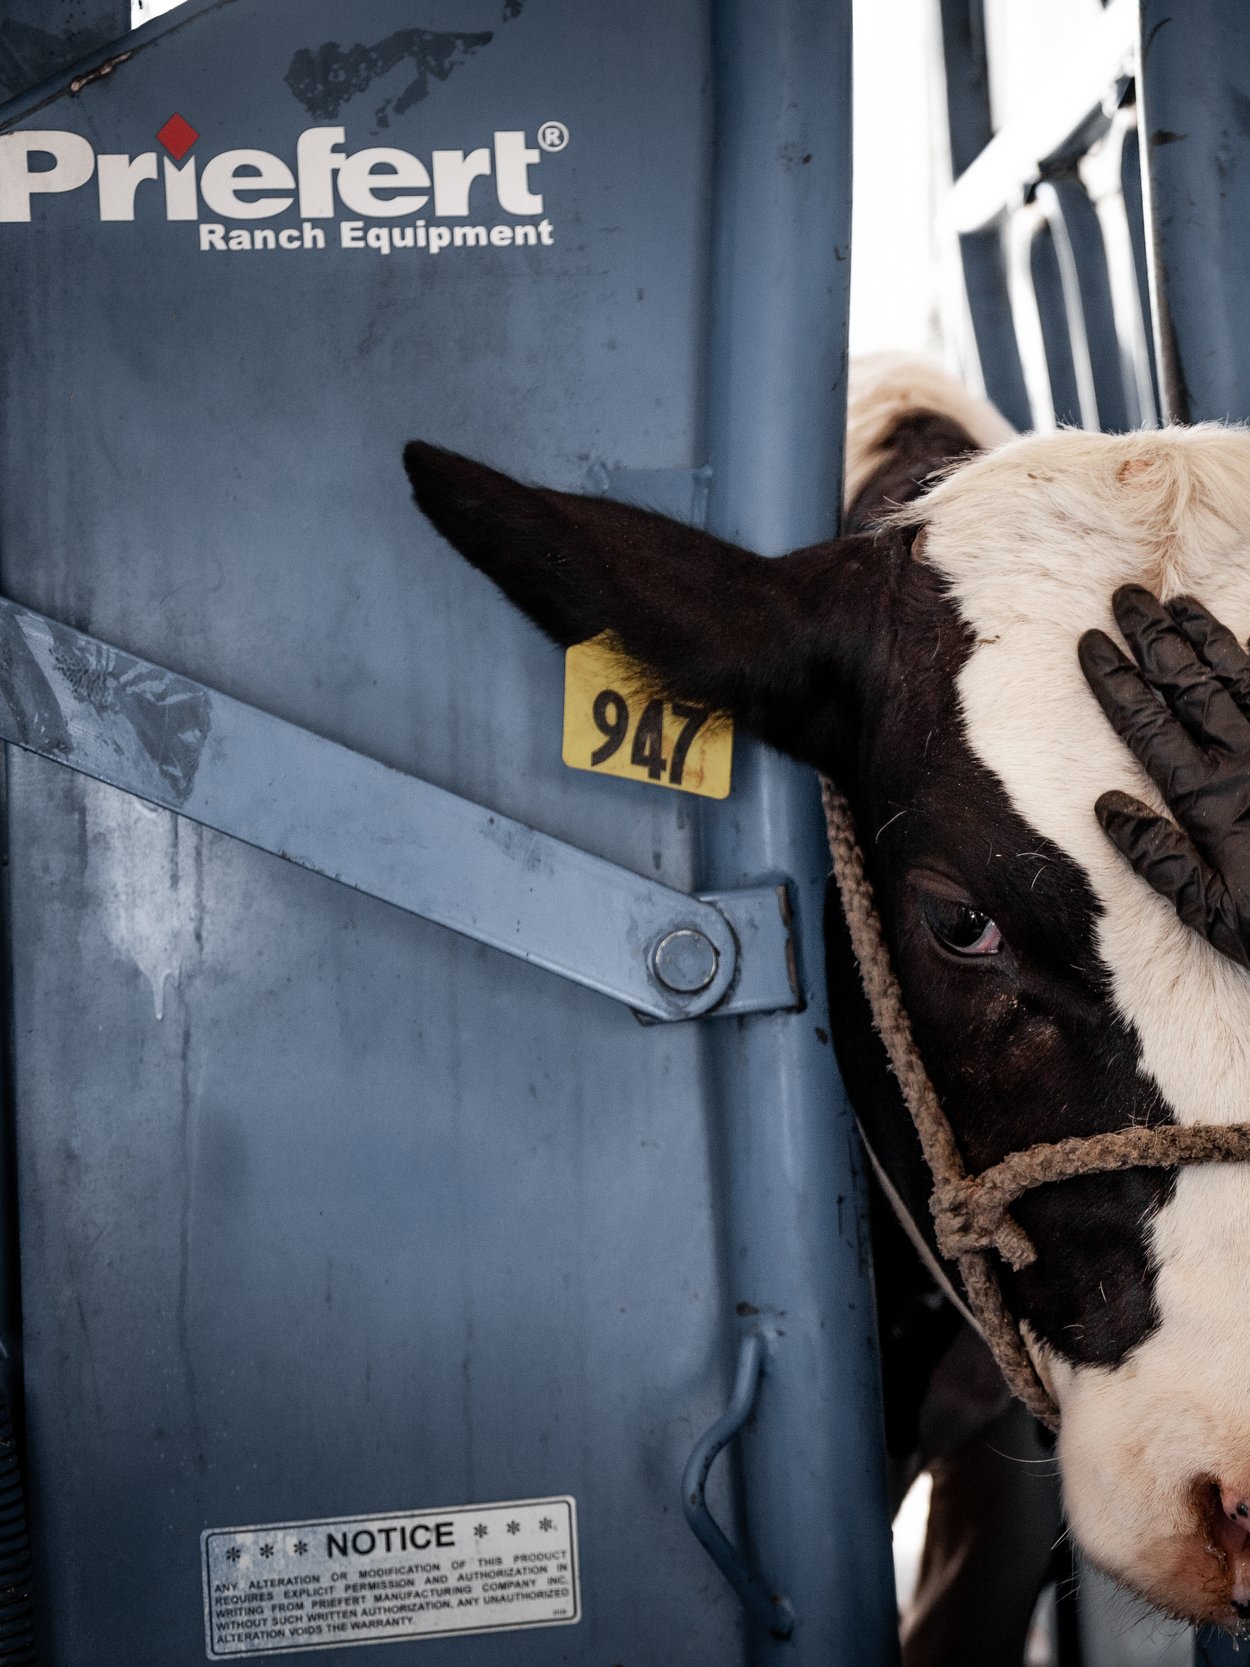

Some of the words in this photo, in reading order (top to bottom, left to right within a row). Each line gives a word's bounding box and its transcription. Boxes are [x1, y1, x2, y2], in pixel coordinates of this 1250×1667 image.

[200, 223, 325, 250] Ranch
[340, 220, 554, 255] Equipment
[591, 689, 707, 785] 947
[327, 1522, 455, 1558] NOTICE
[215, 1582, 238, 1593] ANY
[249, 1575, 320, 1590] ALTERATION
[331, 1572, 347, 1582] OR
[359, 1563, 440, 1579] MODIFICATION
[452, 1560, 466, 1570] OF
[478, 1558, 502, 1567] THIS
[514, 1550, 567, 1563] PRODUCT
[215, 1592, 273, 1606] REQUIRES
[284, 1586, 335, 1599] EXPLICIT
[345, 1578, 415, 1593] PERMISSION
[425, 1576, 447, 1585] AND
[457, 1566, 547, 1582] AUTHORIZATION
[557, 1564, 567, 1572] IN
[216, 1605, 263, 1618] WRITING
[272, 1602, 304, 1613] FROM
[312, 1596, 366, 1609] PRIEFERT
[374, 1586, 472, 1602] MANUFACTURING
[482, 1579, 536, 1592] COMPANY
[216, 1618, 268, 1631] WITHOUT
[272, 1615, 303, 1626] SUCH
[306, 1610, 357, 1623] WRITTEN
[457, 1598, 479, 1608] ANY
[483, 1589, 569, 1605] UNAUTHORIZED
[216, 1629, 285, 1644] ALTERATION
[289, 1626, 322, 1636] VOIDS
[327, 1622, 348, 1632] THE
